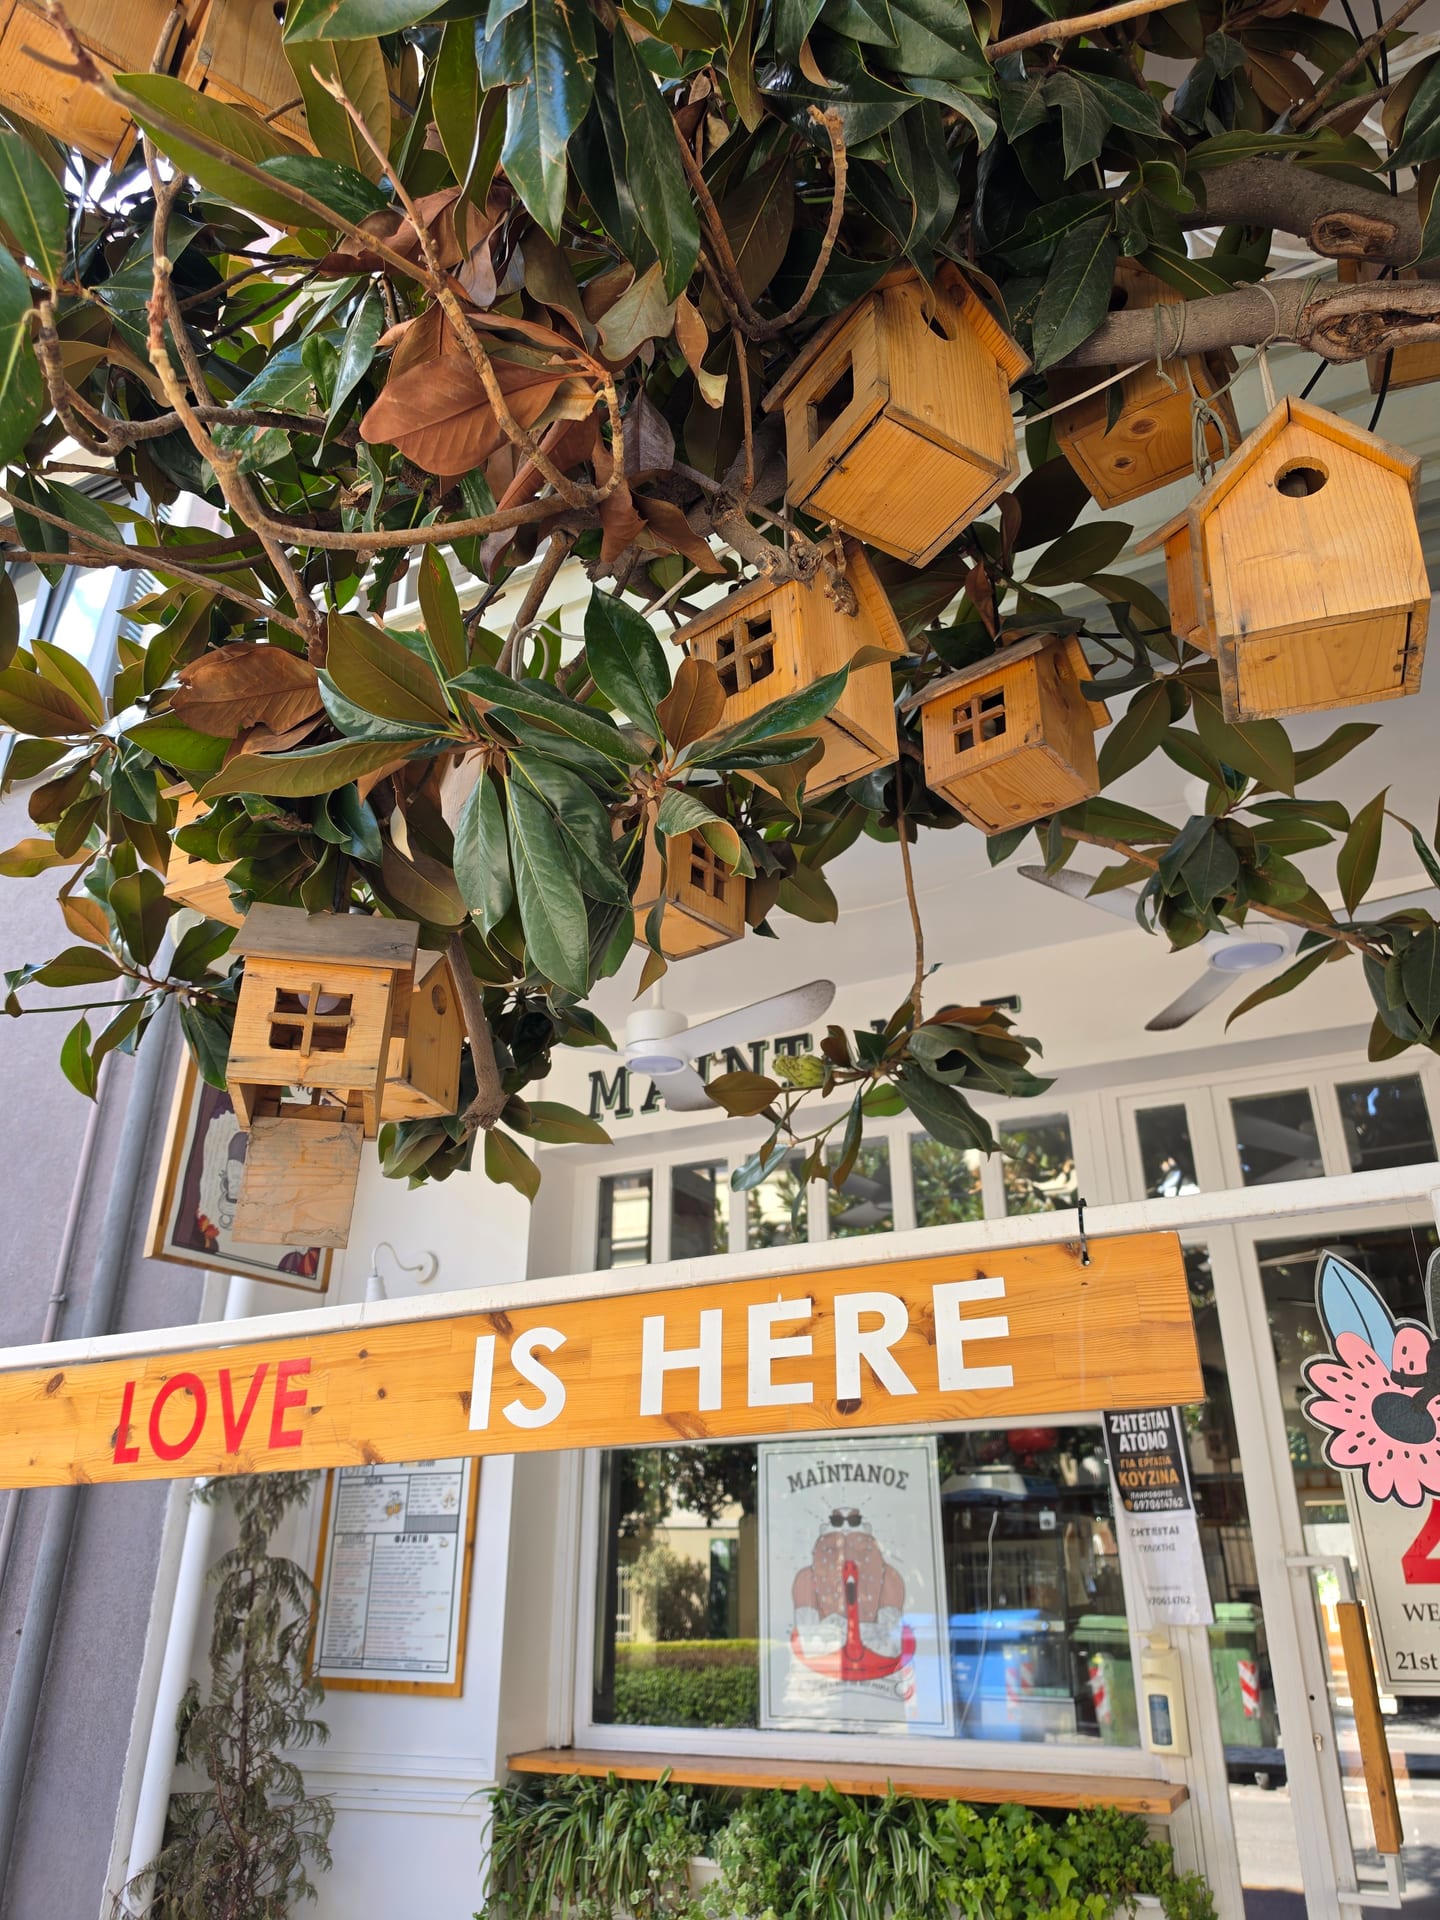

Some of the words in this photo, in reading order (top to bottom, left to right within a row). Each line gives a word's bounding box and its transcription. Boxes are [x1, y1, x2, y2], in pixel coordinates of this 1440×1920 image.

[113, 1357, 312, 1464] LOVE
[468, 1326, 567, 1431] IS
[640, 1276, 1015, 1417] HERE
[1110, 1410, 1170, 1433] ΖΗΤΕΙΤΑΙ
[1120, 1430, 1168, 1453] ΑΤΟΜΟ
[787, 1461, 909, 1493] ΜΑΪΝΤΑΝΟΣ
[1118, 1468, 1180, 1488] ΚΟΥΖΙΝΑ
[1395, 1651, 1438, 1671] 21st
